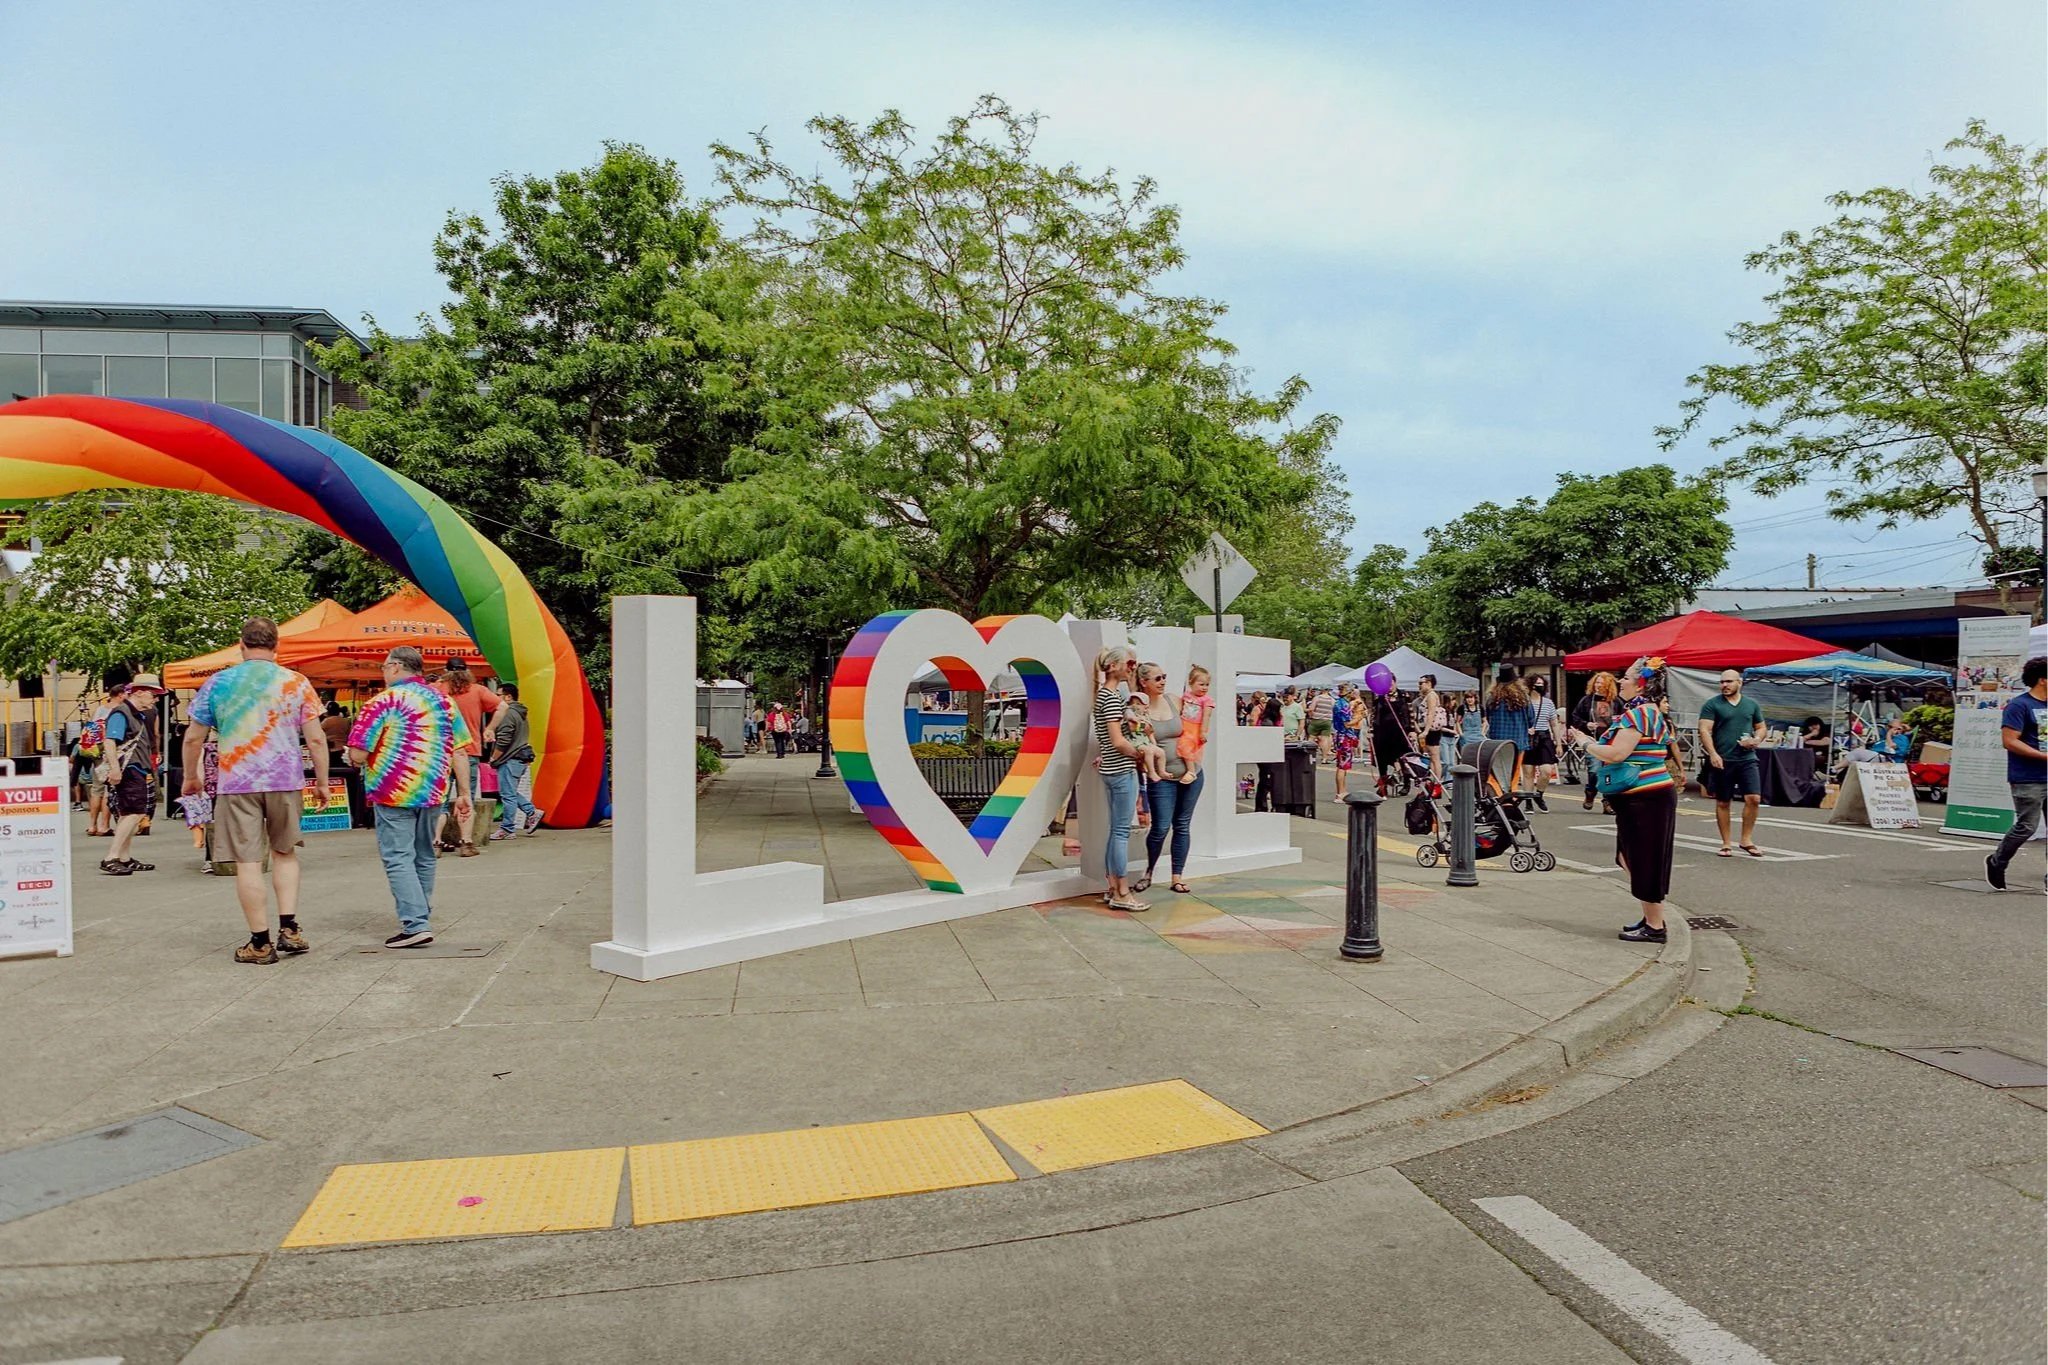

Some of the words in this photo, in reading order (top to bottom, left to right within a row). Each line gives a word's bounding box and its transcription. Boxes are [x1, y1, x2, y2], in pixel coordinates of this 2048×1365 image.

[390, 620, 446, 628] DISCOVER
[364, 626, 469, 637] BURIEN
[5, 790, 42, 802] YOU!
[0, 806, 40, 815] Sponsors
[17, 828, 56, 837] amazon
[20, 881, 51, 889] BECU
